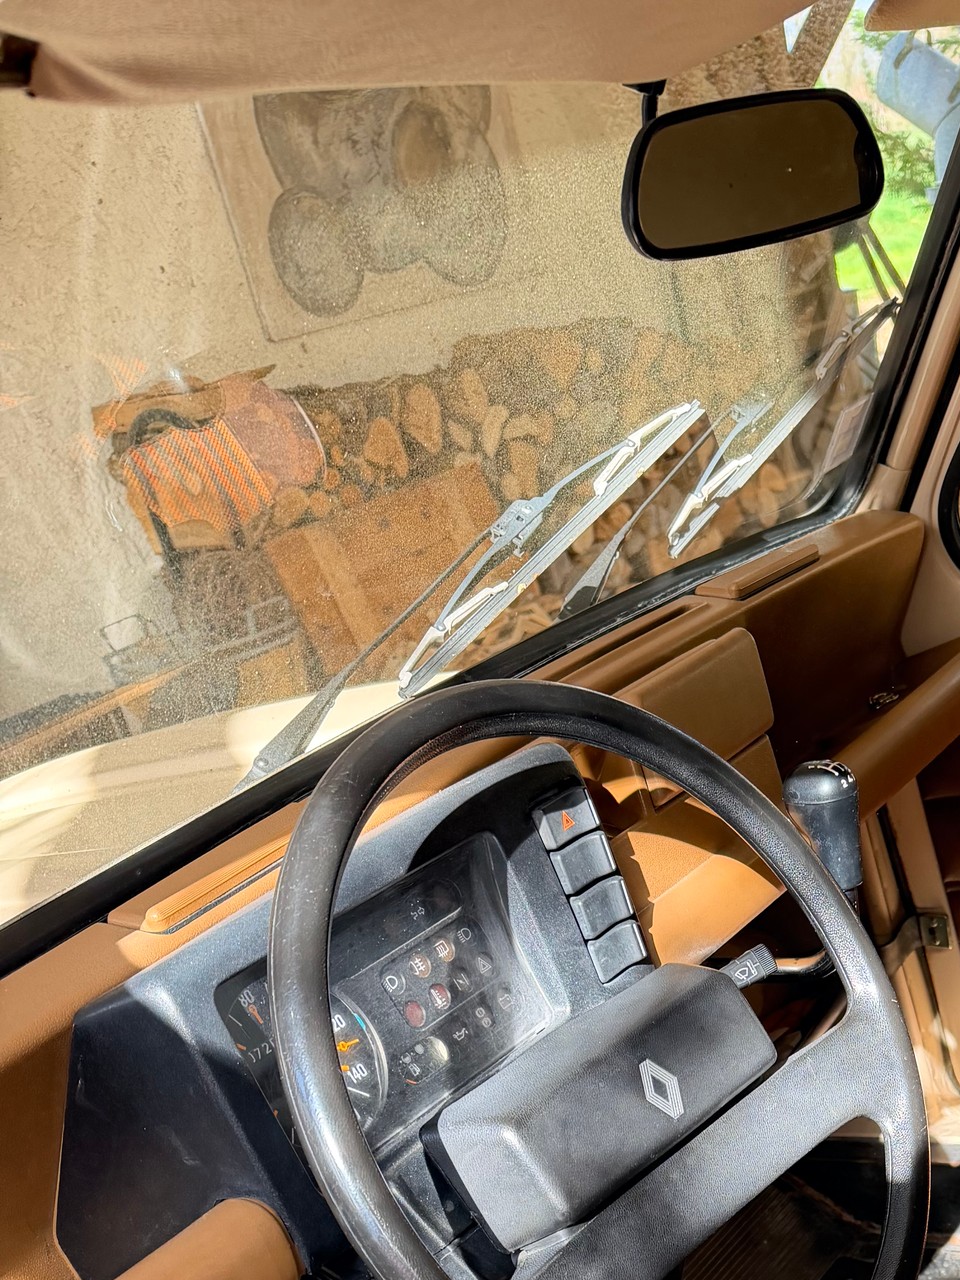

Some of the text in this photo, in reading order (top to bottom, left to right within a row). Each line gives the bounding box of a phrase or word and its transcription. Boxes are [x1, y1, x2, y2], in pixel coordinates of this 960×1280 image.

[841, 779, 848, 788] 2
[238, 990, 255, 1007] 80
[347, 1063, 368, 1084] 140
